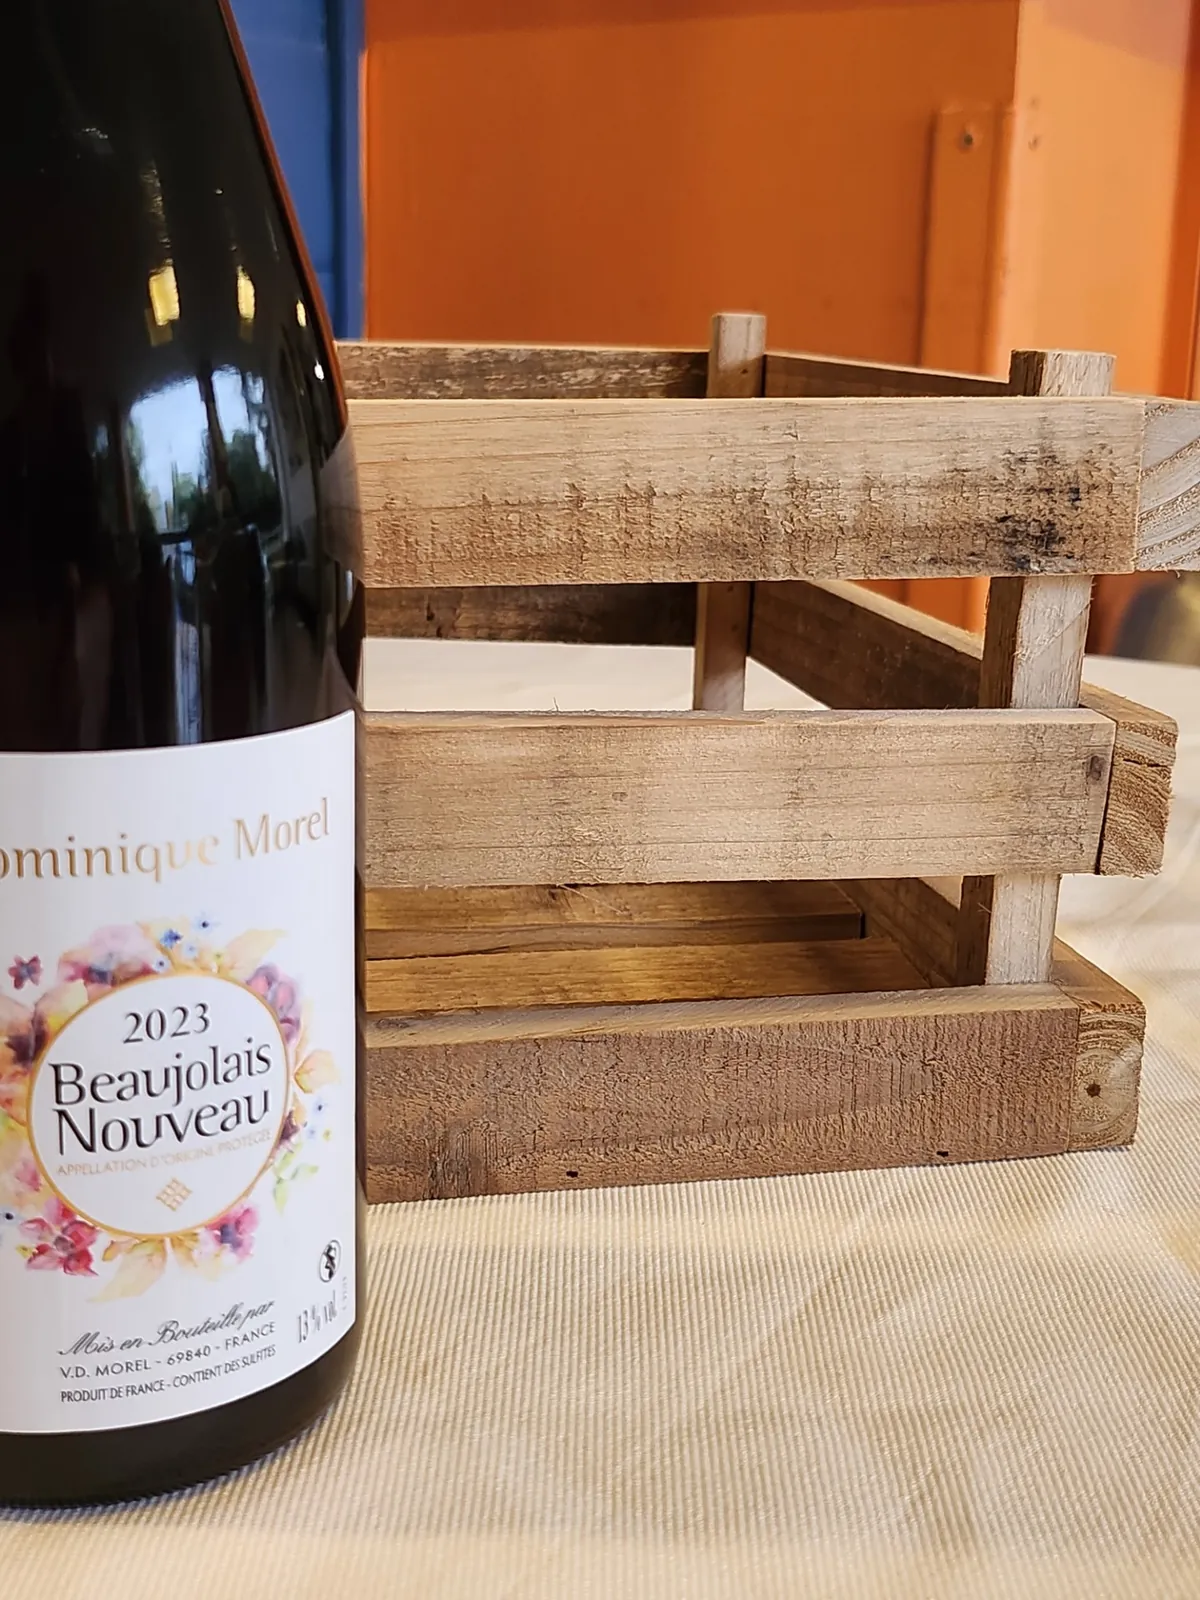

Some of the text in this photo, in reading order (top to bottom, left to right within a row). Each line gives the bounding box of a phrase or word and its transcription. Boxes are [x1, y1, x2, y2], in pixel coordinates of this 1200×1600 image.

[233, 797, 329, 860] Morel
[122, 1002, 211, 1044] 2023
[48, 1037, 272, 1106] Beaujolais
[52, 1089, 270, 1155] Nouveau
[57, 1159, 147, 1176] APPELLATION
[57, 1300, 275, 1356] Mis en Bouteille par
[60, 1366, 91, 1379] V.D.
[95, 1358, 151, 1378] MOREL
[166, 1345, 211, 1366] 69840
[225, 1321, 276, 1351] FRANCE
[298, 1309, 309, 1344] 13
[61, 1388, 107, 1402] PRODUIT
[110, 1386, 123, 1399] DE
[125, 1380, 165, 1397] FRANCE
[172, 1365, 223, 1388] CONTIENT
[224, 1360, 241, 1374] DES
[241, 1344, 276, 1369] SULFITES
